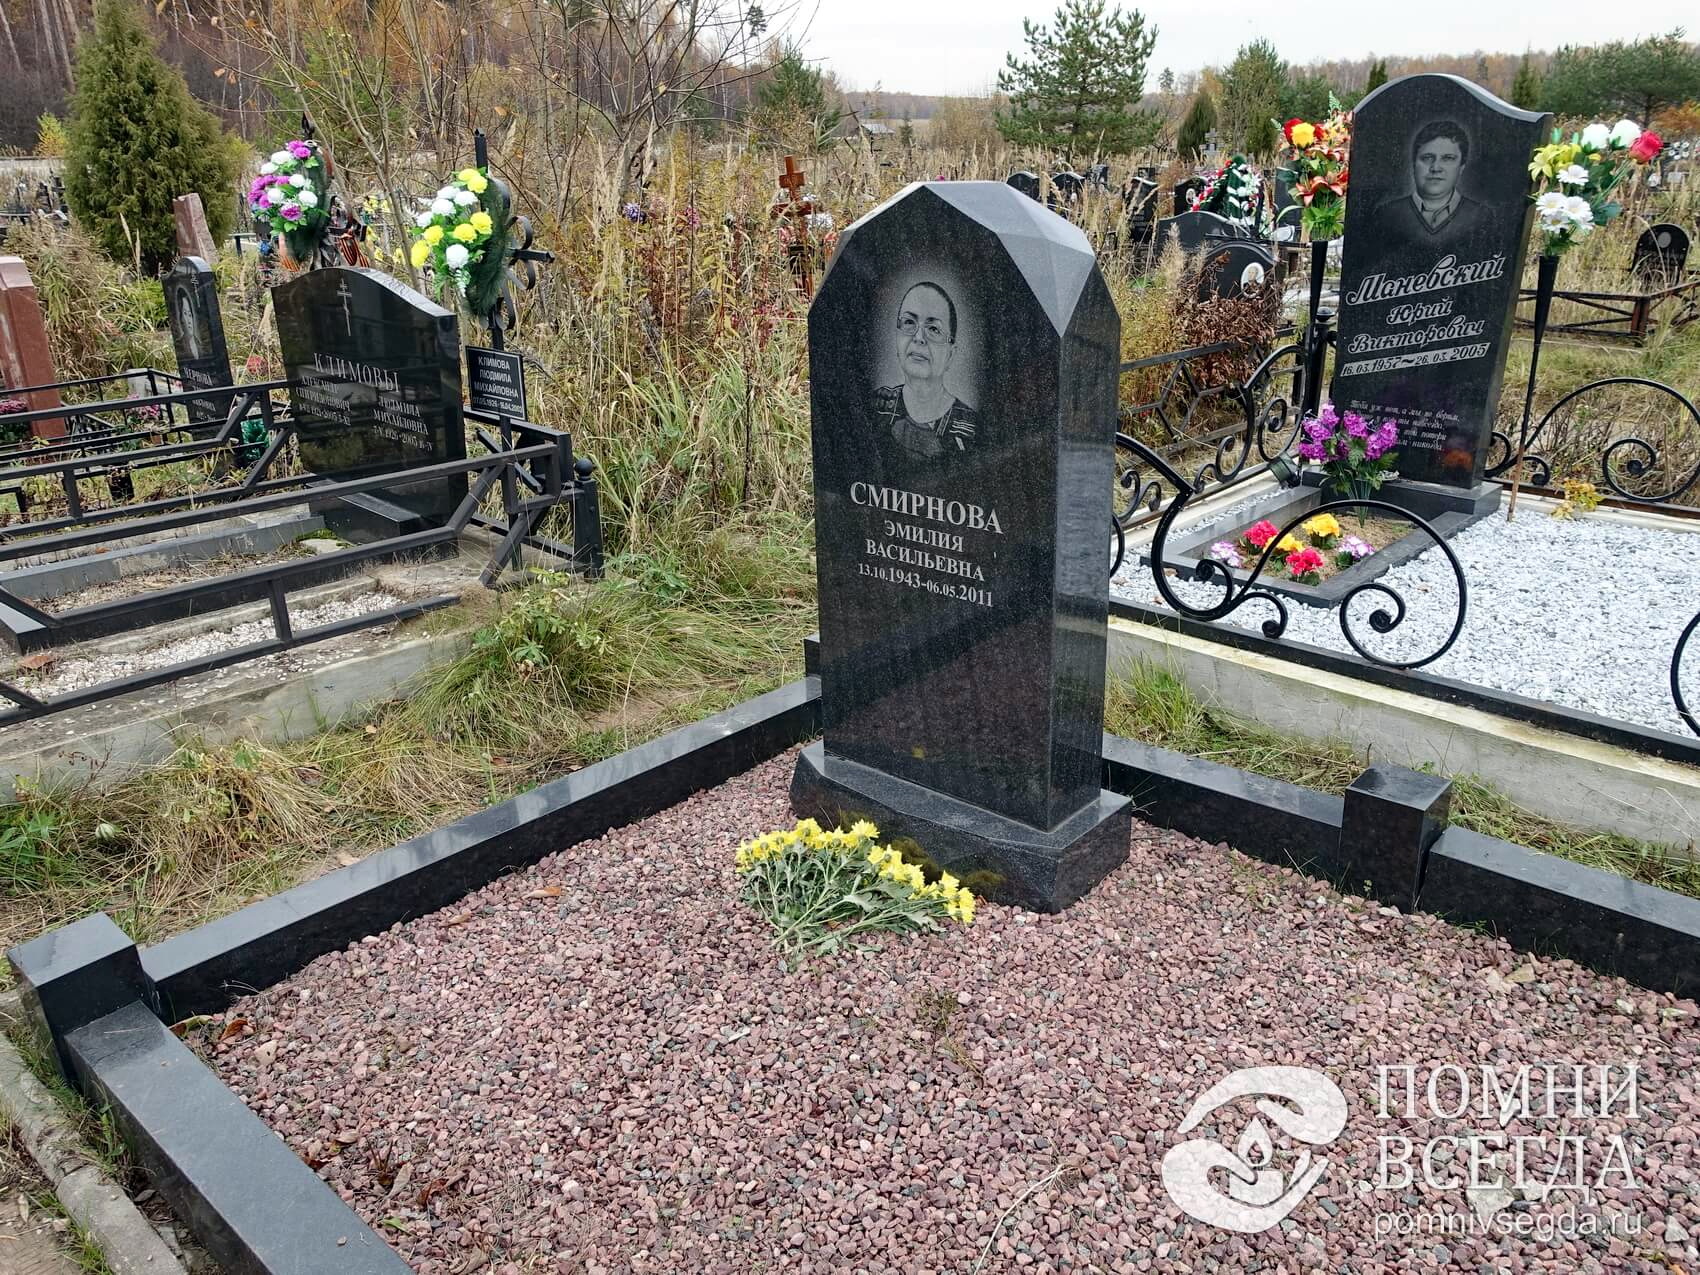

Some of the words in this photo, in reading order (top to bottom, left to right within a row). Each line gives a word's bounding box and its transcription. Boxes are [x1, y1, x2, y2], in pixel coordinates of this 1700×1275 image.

[1346, 250, 1506, 305] Маневский
[1386, 295, 1454, 326] Юрий
[1348, 315, 1485, 354] Викторович
[313, 352, 400, 393] КЛИМОВЫ
[478, 356, 511, 370] КЛИМОВА
[479, 369, 512, 383] ЛЮДМИЛА
[474, 381, 519, 398] МИХАЙЛОВНА
[850, 481, 1004, 535] СМИРНОВА
[884, 519, 964, 552] ЭМИЛИЯ
[865, 538, 985, 582] ВАСИЛЬЕВНА
[858, 563, 994, 608] 13.10.1943-06.05.2011
